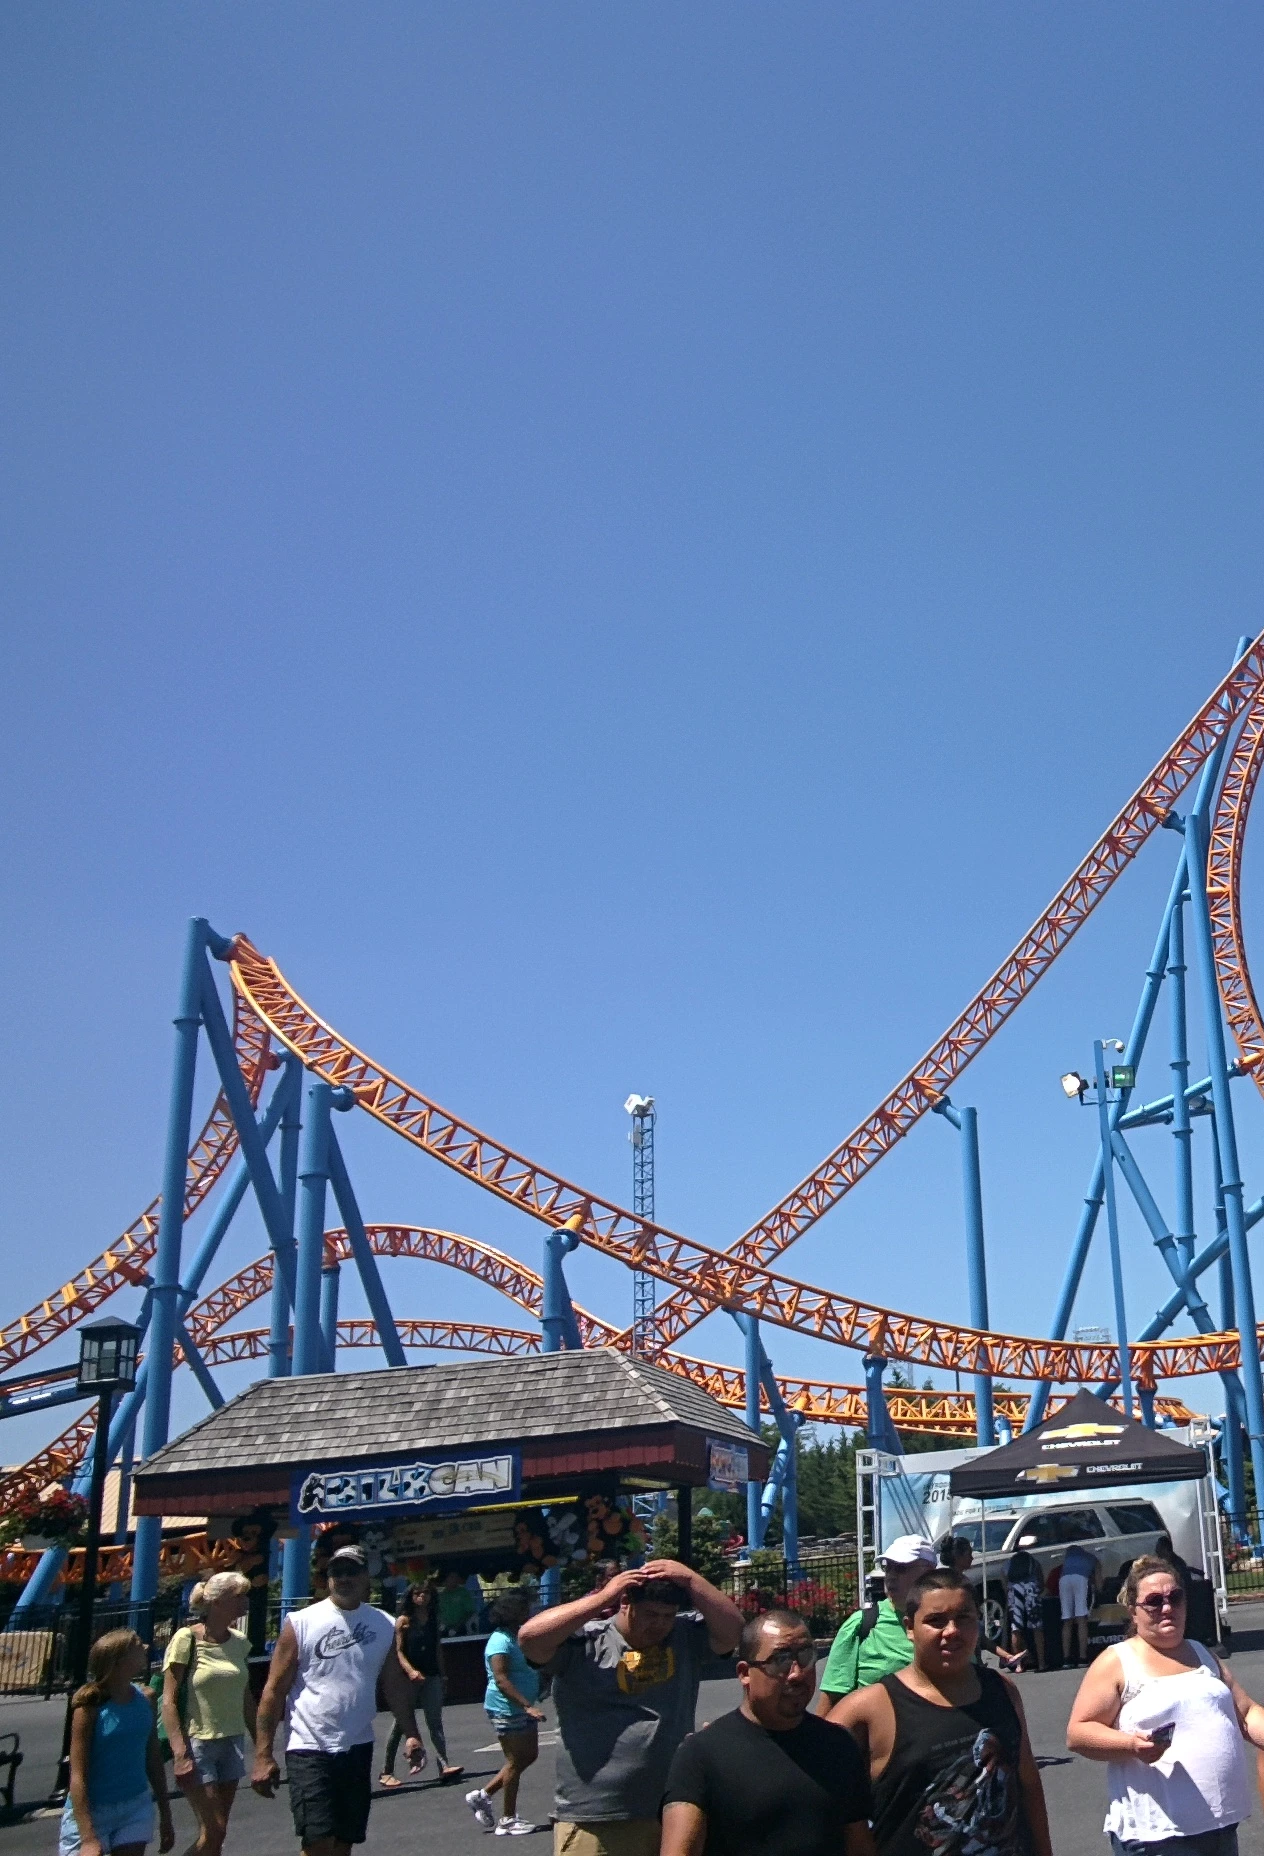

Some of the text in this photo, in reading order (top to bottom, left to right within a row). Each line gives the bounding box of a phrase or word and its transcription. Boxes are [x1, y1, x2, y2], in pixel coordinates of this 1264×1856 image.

[1041, 1439, 1121, 1450] CHEVROLET
[1086, 1462, 1143, 1474] CHEVROLET
[428, 1456, 512, 1495] CAN
[1087, 1634, 1126, 1645] HEVRO
